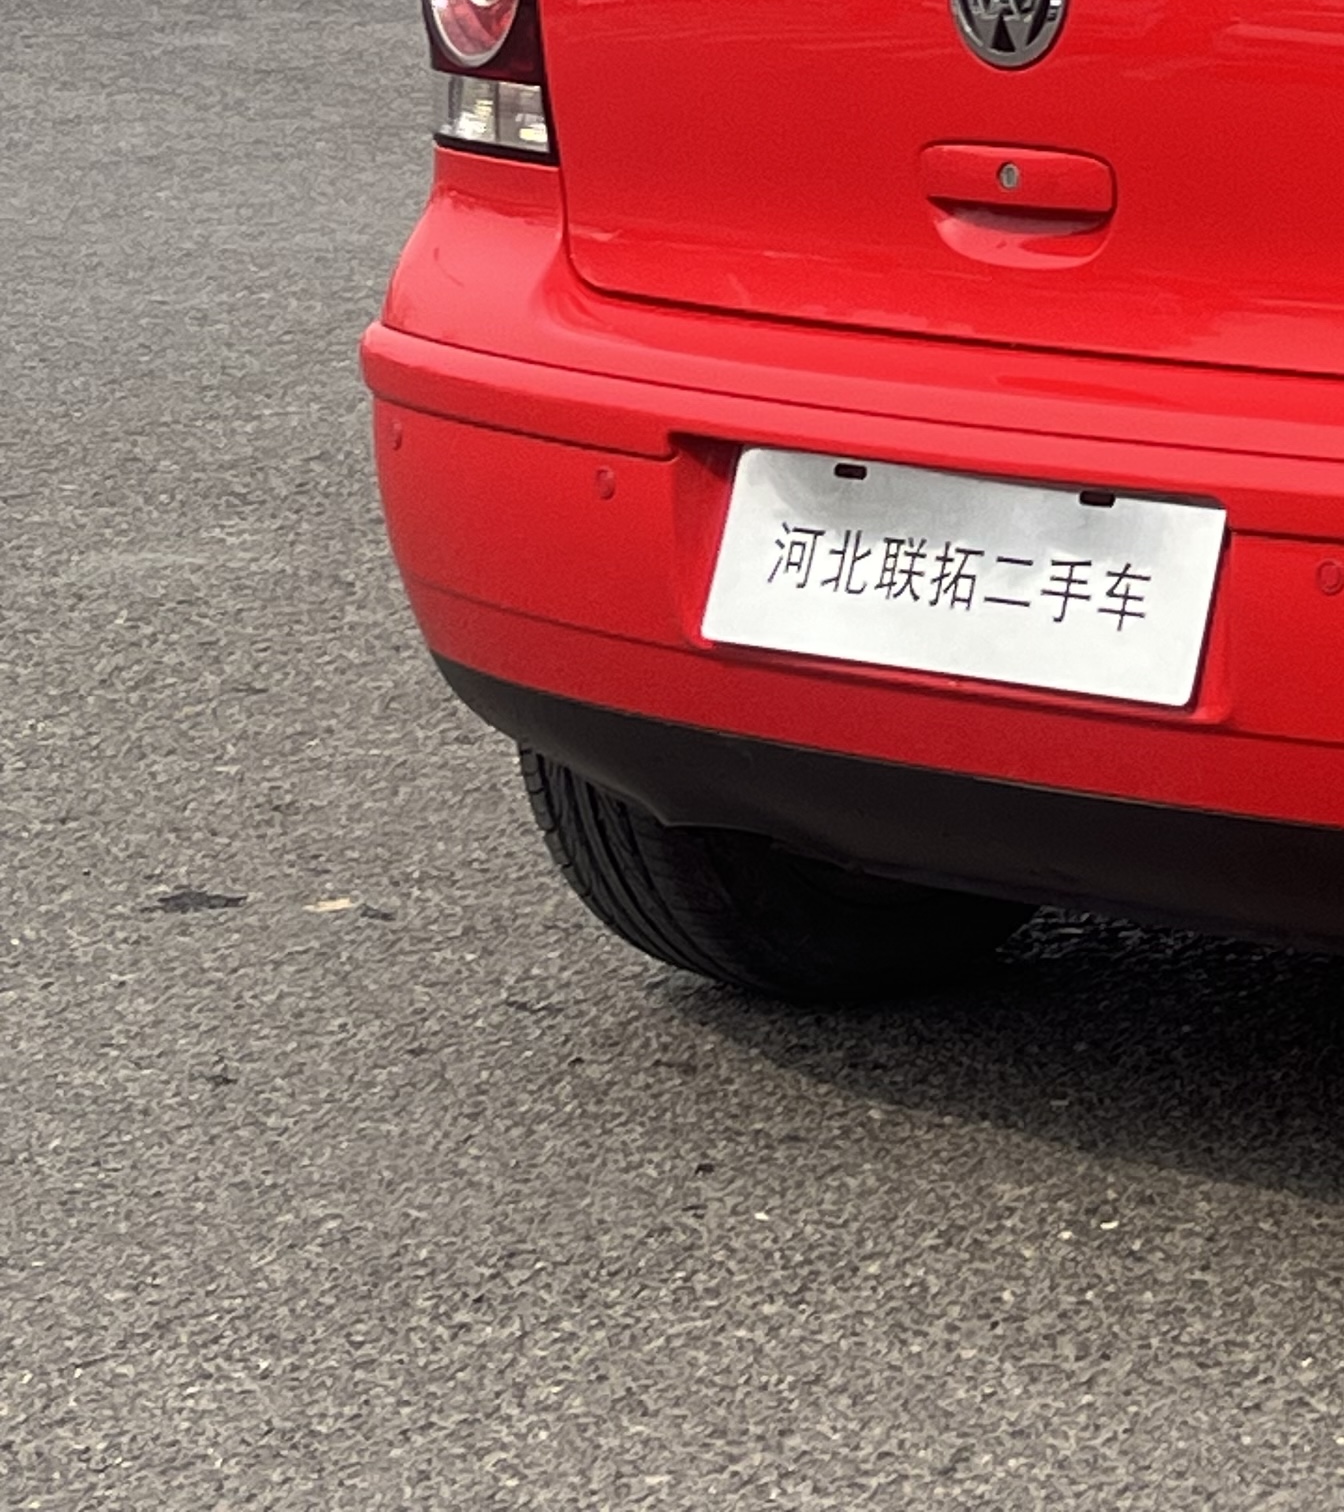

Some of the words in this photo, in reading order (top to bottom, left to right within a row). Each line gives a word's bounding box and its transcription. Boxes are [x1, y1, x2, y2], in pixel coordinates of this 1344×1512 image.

[767, 521, 1153, 633] 河北联拓二手车
